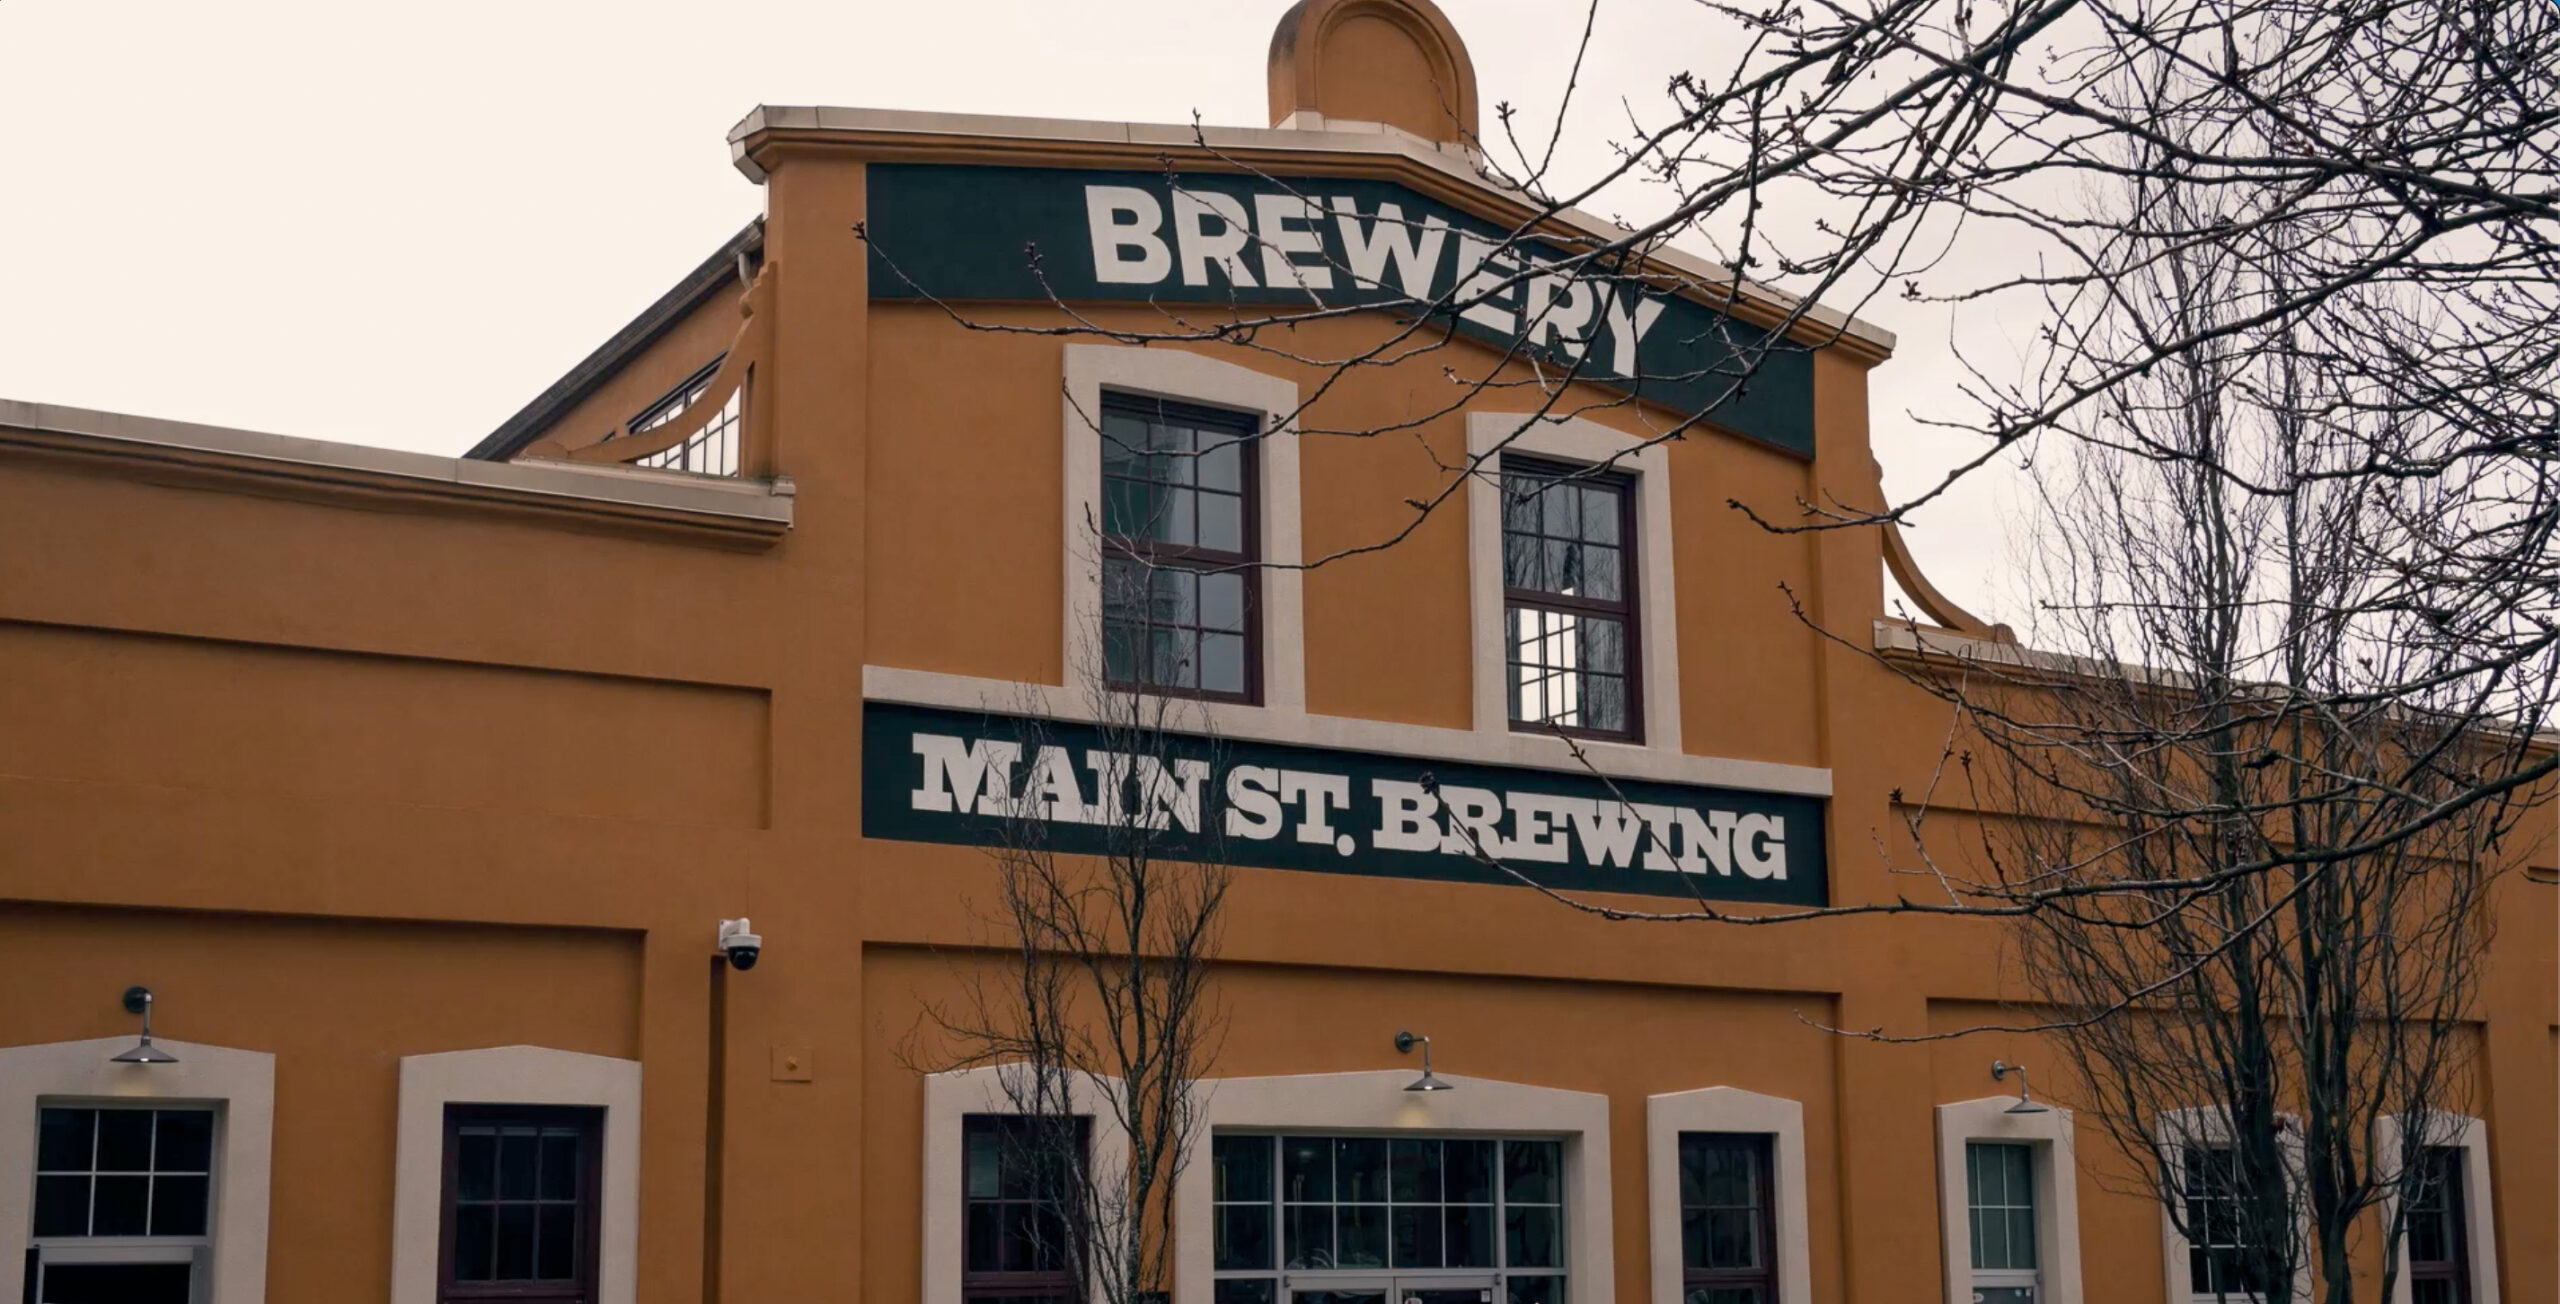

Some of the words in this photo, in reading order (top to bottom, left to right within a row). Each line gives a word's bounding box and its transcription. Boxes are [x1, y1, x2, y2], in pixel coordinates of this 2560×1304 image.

[1085, 185, 1665, 377] BREWERY
[911, 732, 1211, 832] MAIN
[1226, 765, 1356, 856] ST.
[1372, 778, 1788, 881] BREWING
